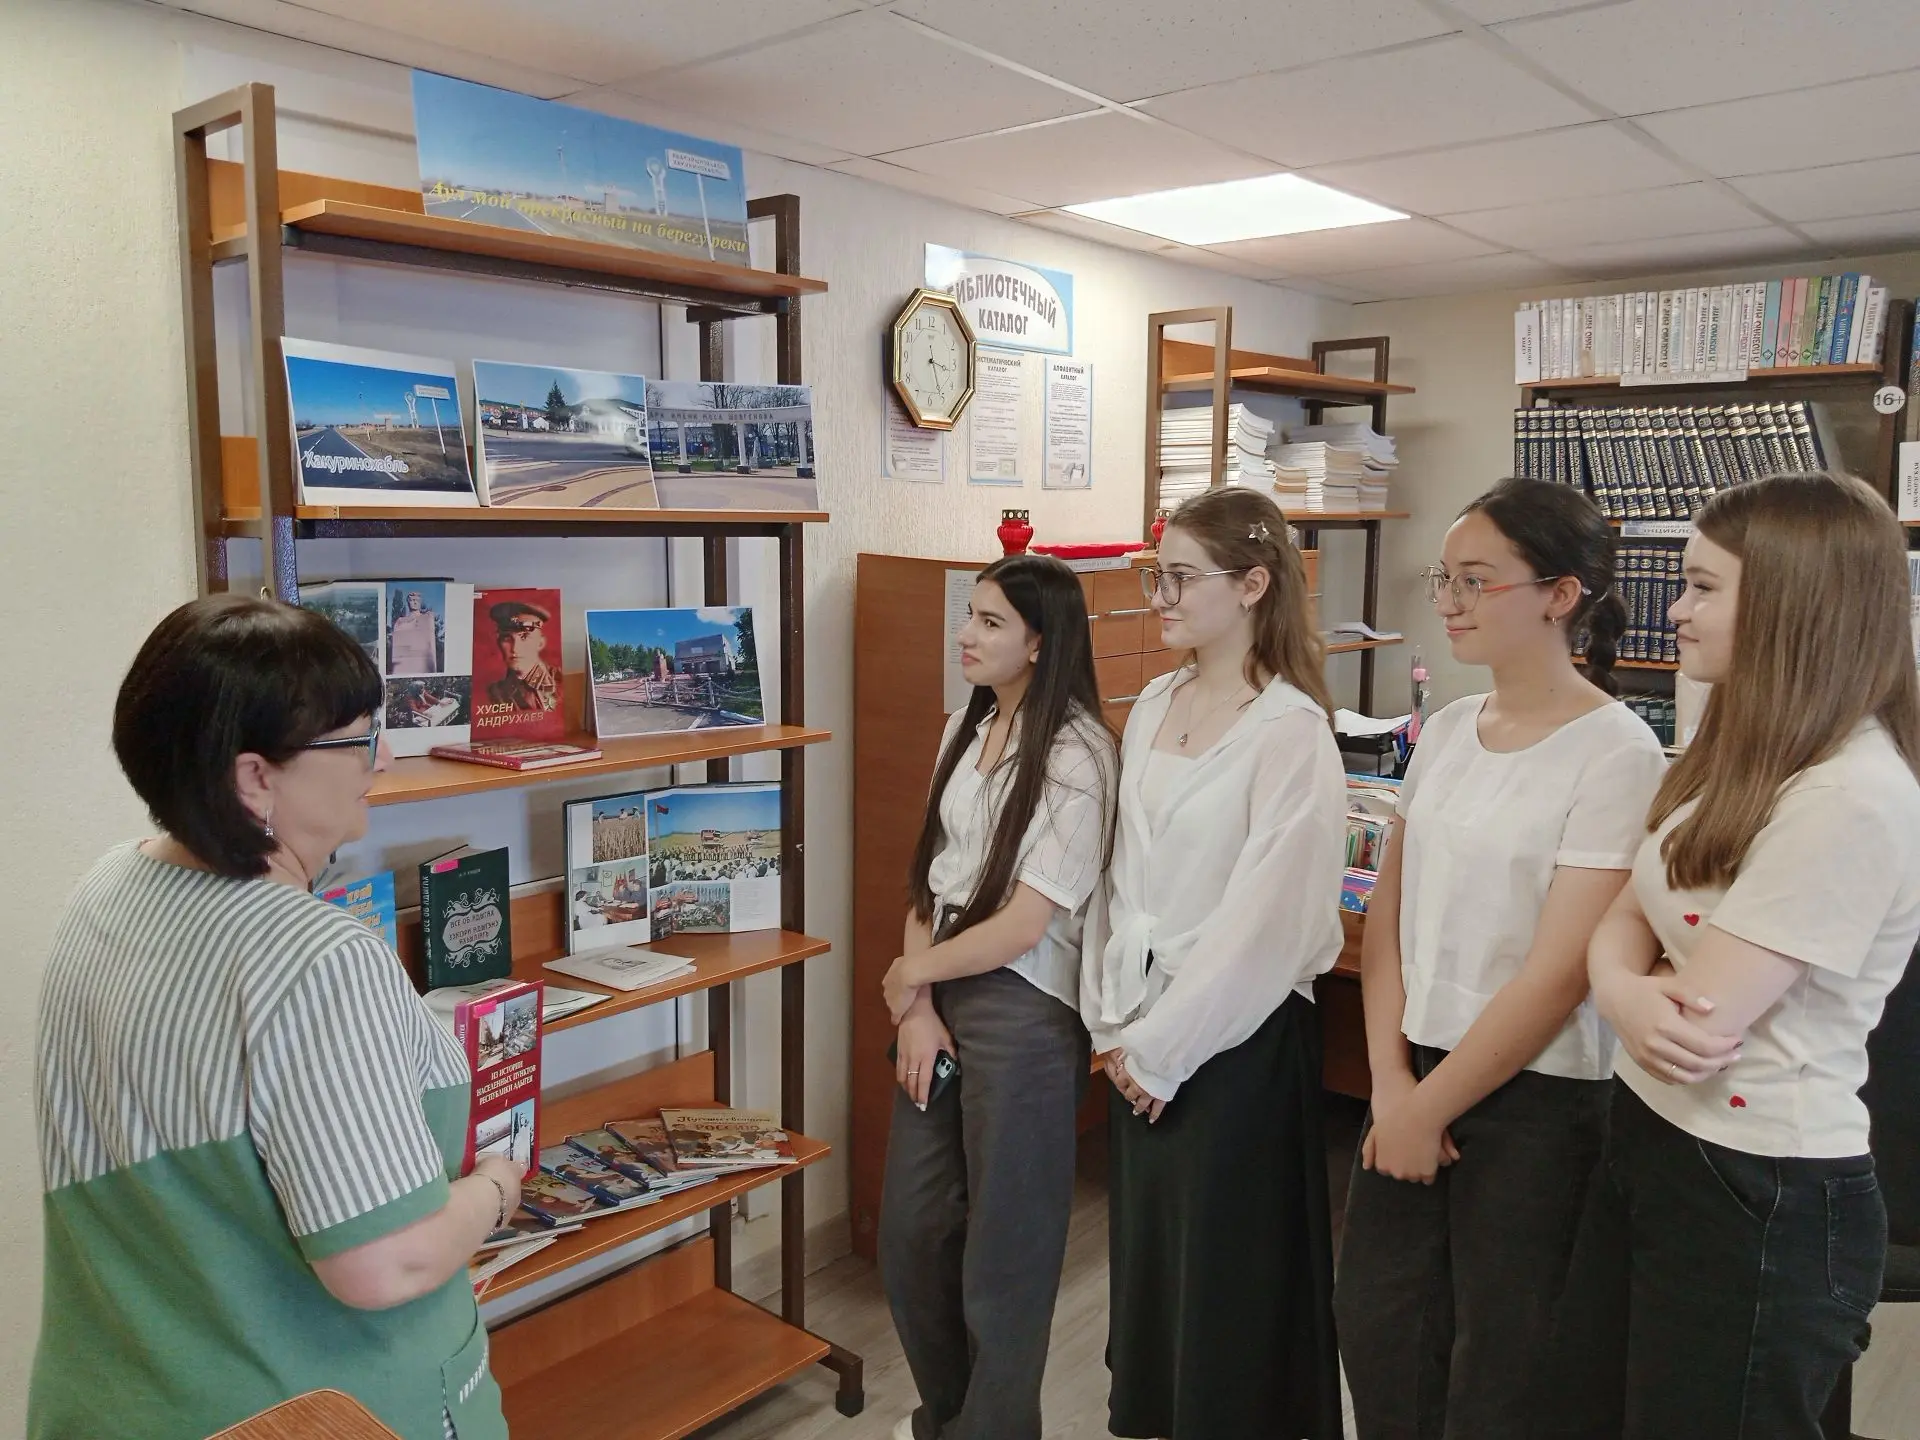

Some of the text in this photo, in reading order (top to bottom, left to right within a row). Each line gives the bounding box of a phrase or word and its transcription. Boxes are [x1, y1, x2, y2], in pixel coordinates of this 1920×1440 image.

[517, 200, 627, 230] прекрасный
[632, 221, 652, 237] на
[657, 217, 707, 249] берегу
[710, 234, 748, 254] реки
[928, 315, 936, 328] 12
[978, 307, 1029, 336] КАТАЛОГ
[1708, 323, 1718, 355] ПОЗНАЮ
[1752, 321, 1761, 354] ПОЗНАЮ
[903, 350, 909, 363] 9
[905, 372, 911, 384] 8
[914, 389, 920, 401] 7
[927, 394, 933, 407] 6
[1874, 393, 1905, 406] 16+
[303, 451, 409, 474] Хакуринохабль
[476, 703, 514, 715] ХУСЕН
[476, 712, 544, 728] АНДРУХАЕВ
[450, 919, 461, 929] ВСЕ
[462, 916, 471, 925] ОБ
[491, 1060, 524, 1081] ИЗ ИСТОРИИ
[476, 1064, 537, 1097] НАСЕЛЕННЫХ ПУНКТОВ
[479, 1075, 533, 1106] РЕСПУБЛИКИ АДЫГЕИ
